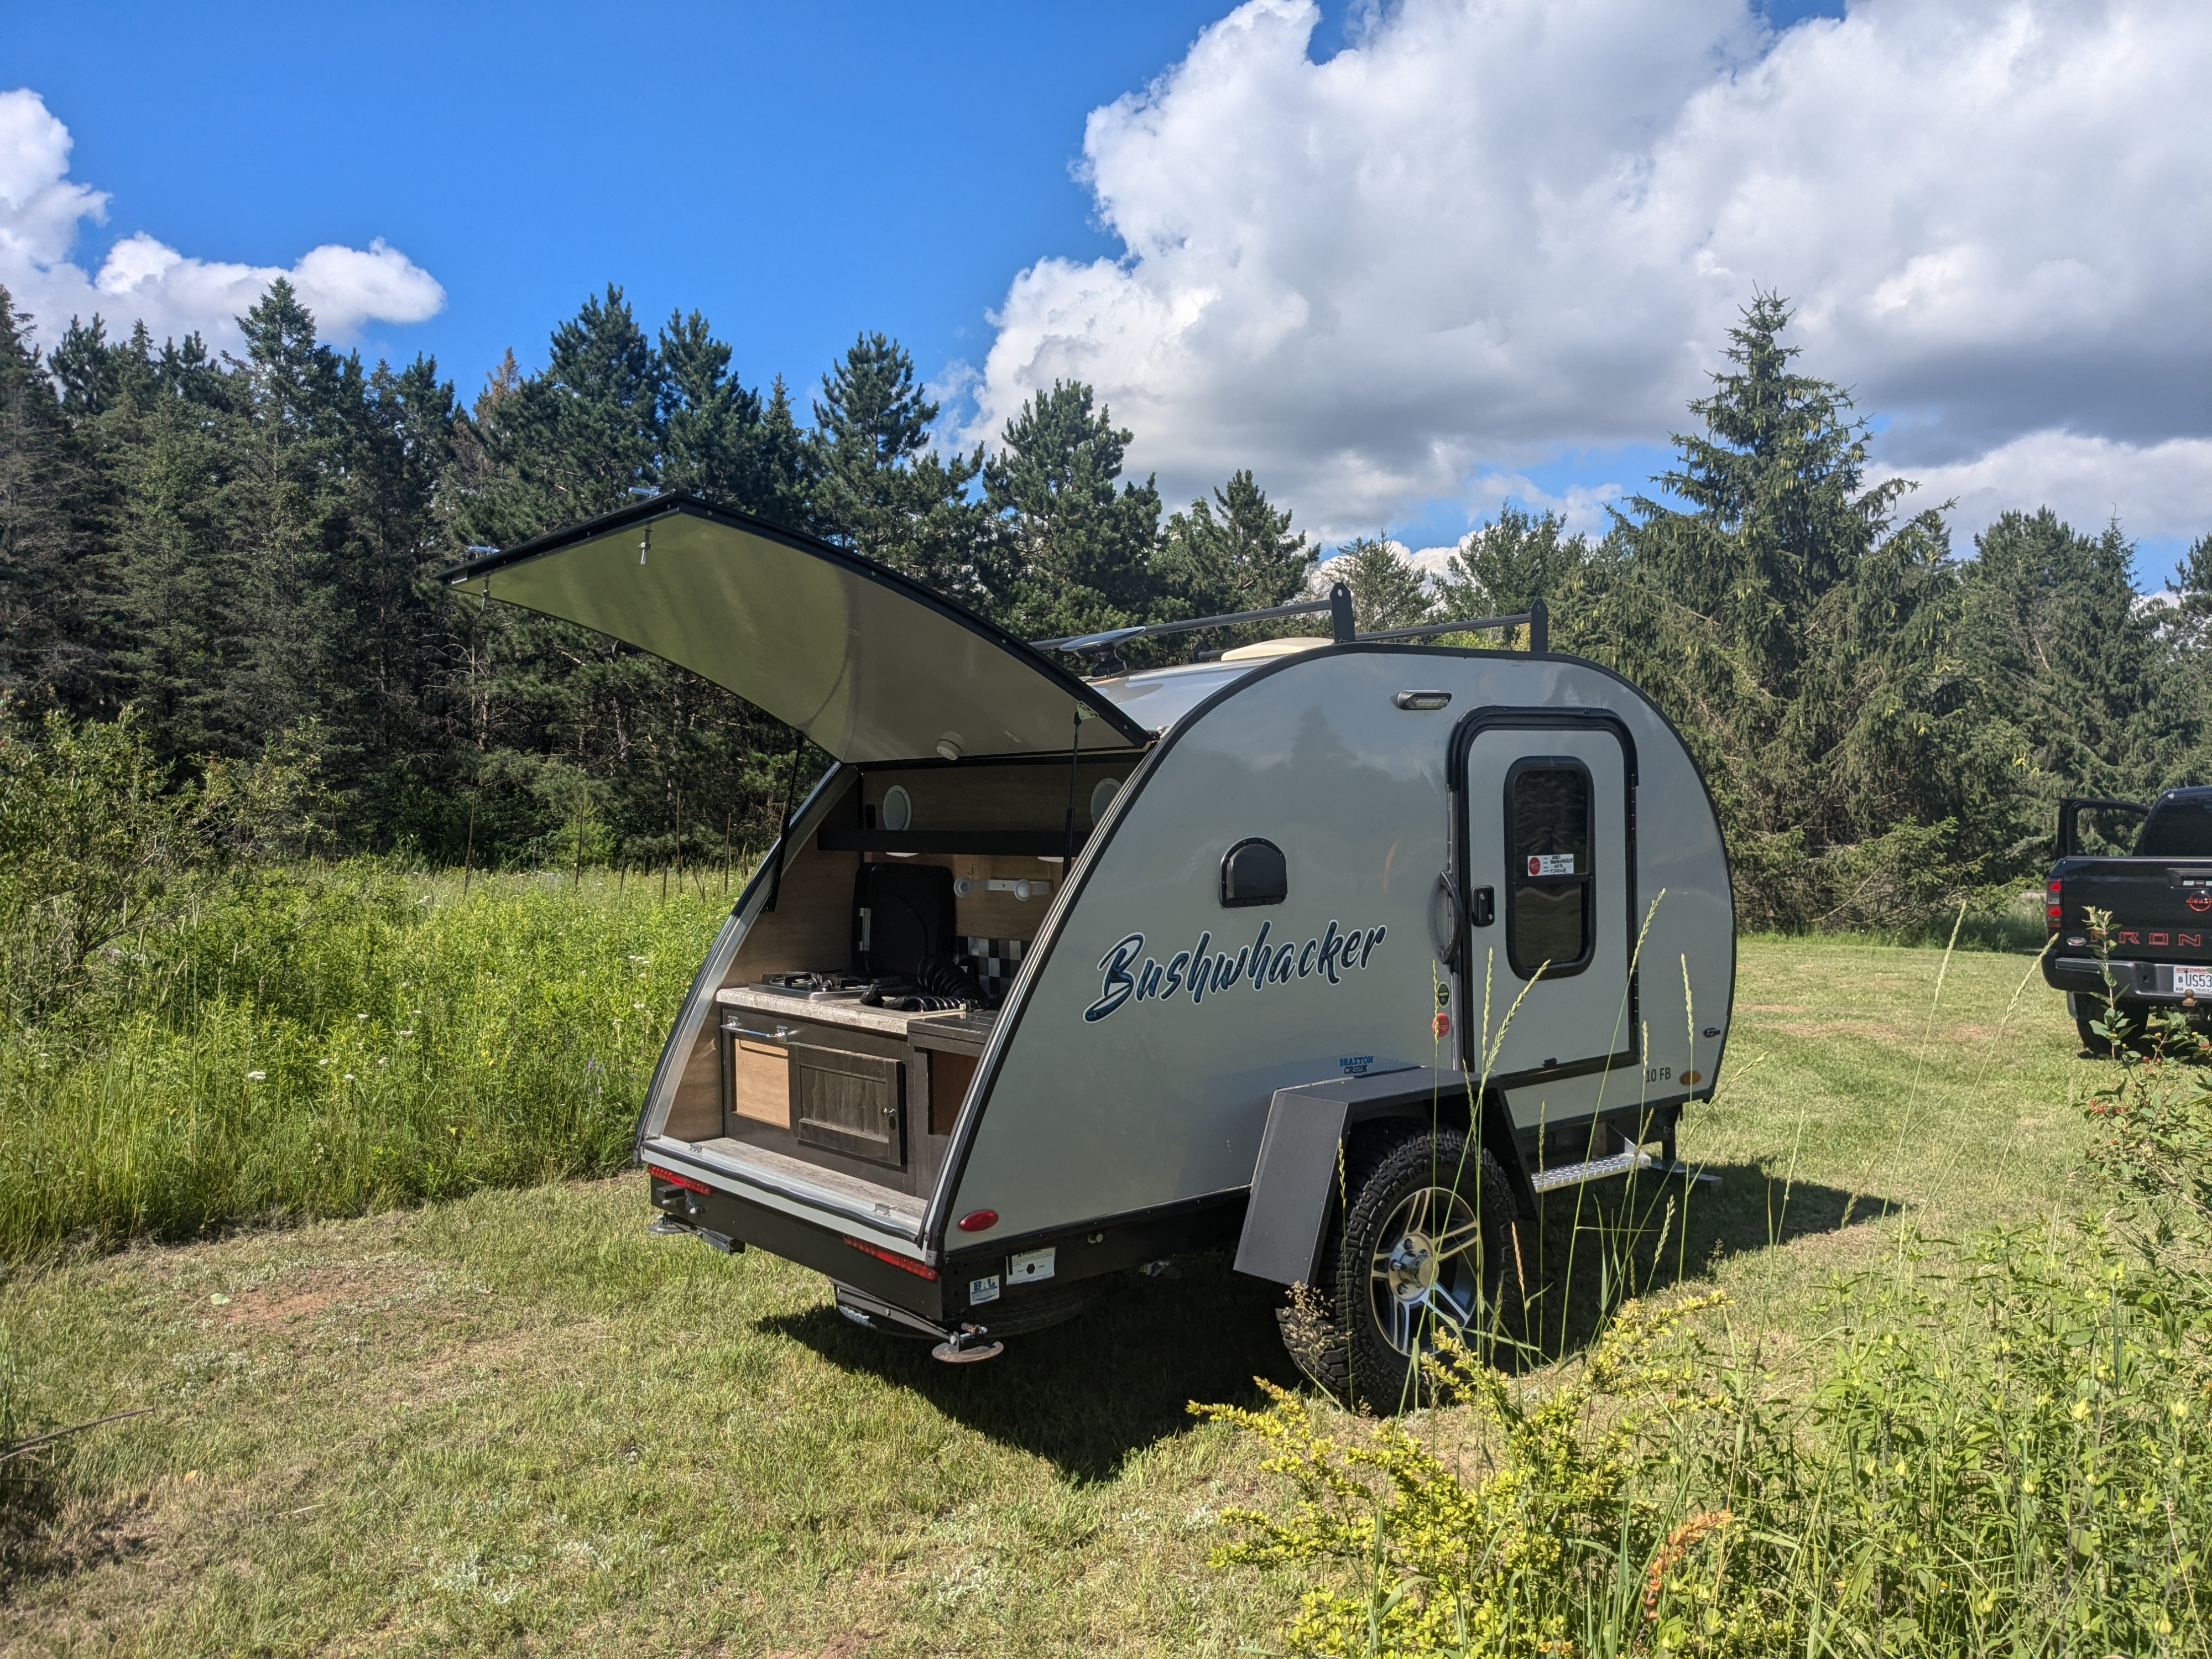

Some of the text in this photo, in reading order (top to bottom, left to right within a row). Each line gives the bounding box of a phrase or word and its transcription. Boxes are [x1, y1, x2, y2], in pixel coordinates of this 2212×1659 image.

[1083, 920, 1387, 1023] Bushwhacker
[1339, 1056, 1374, 1067] BRAXTON
[1646, 1067, 1671, 1083] 10 FB
